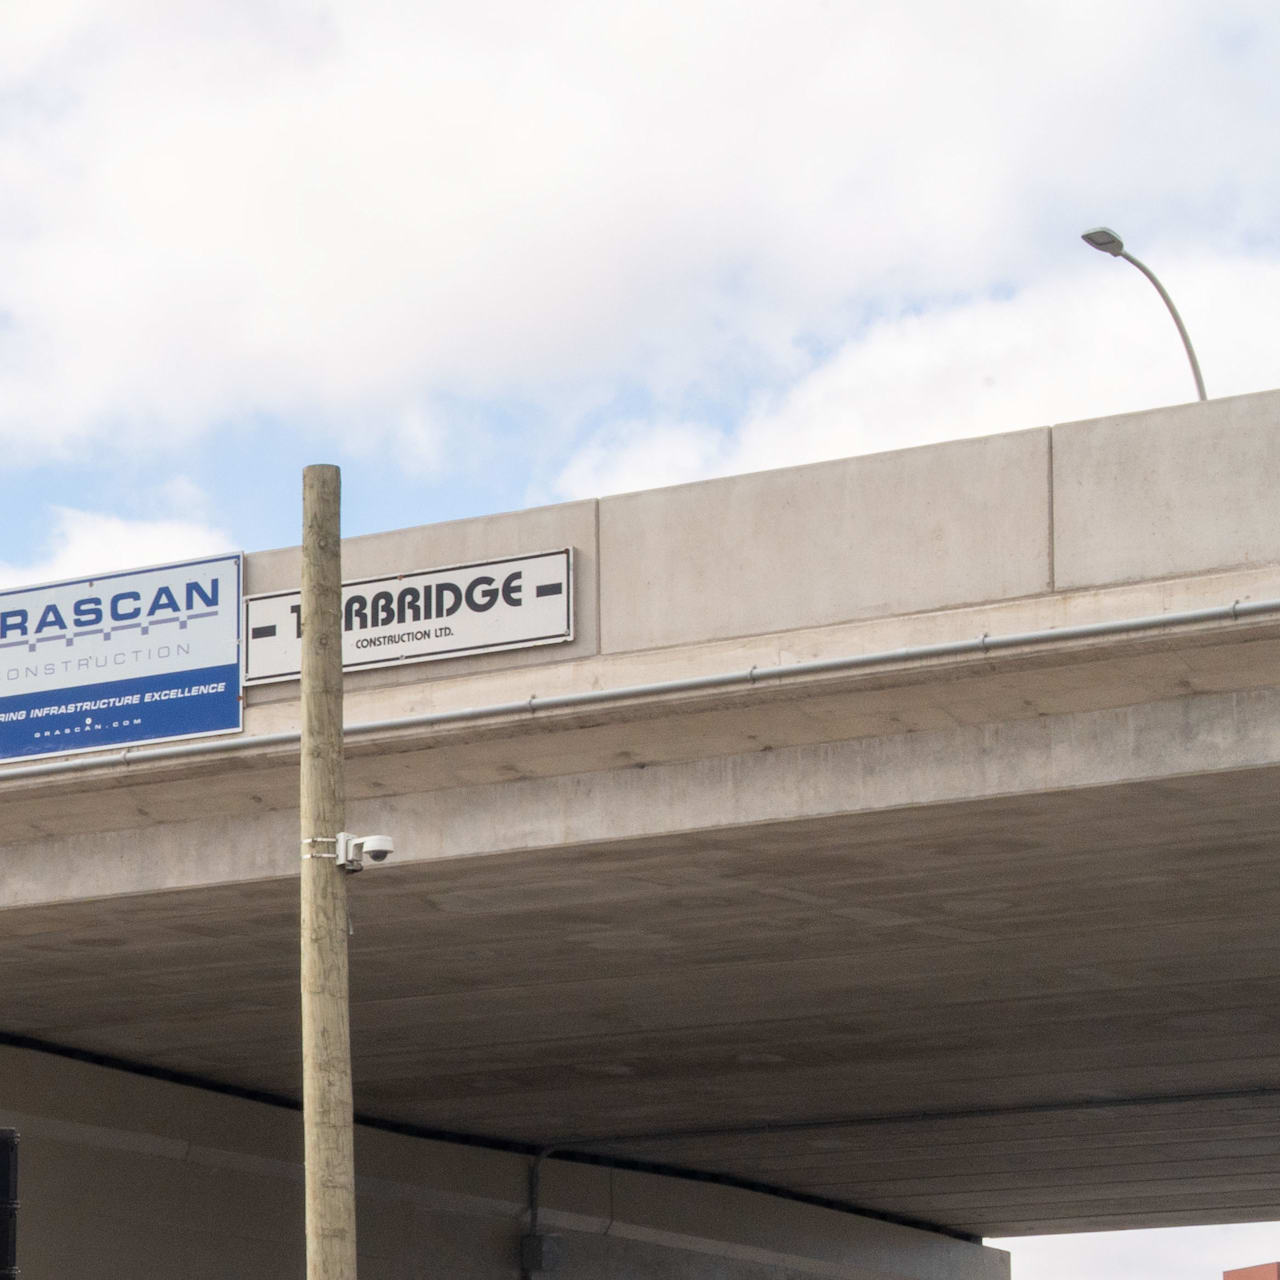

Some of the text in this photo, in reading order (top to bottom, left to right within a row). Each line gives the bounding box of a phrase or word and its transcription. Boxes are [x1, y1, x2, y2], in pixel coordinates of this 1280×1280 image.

[290, 571, 523, 639] TRBRIDGE
[355, 626, 454, 649] CONSTRUCTION LTD.
[29, 693, 141, 719] INFRASTRUCTURE
[144, 682, 227, 703] EXCELLENCE
